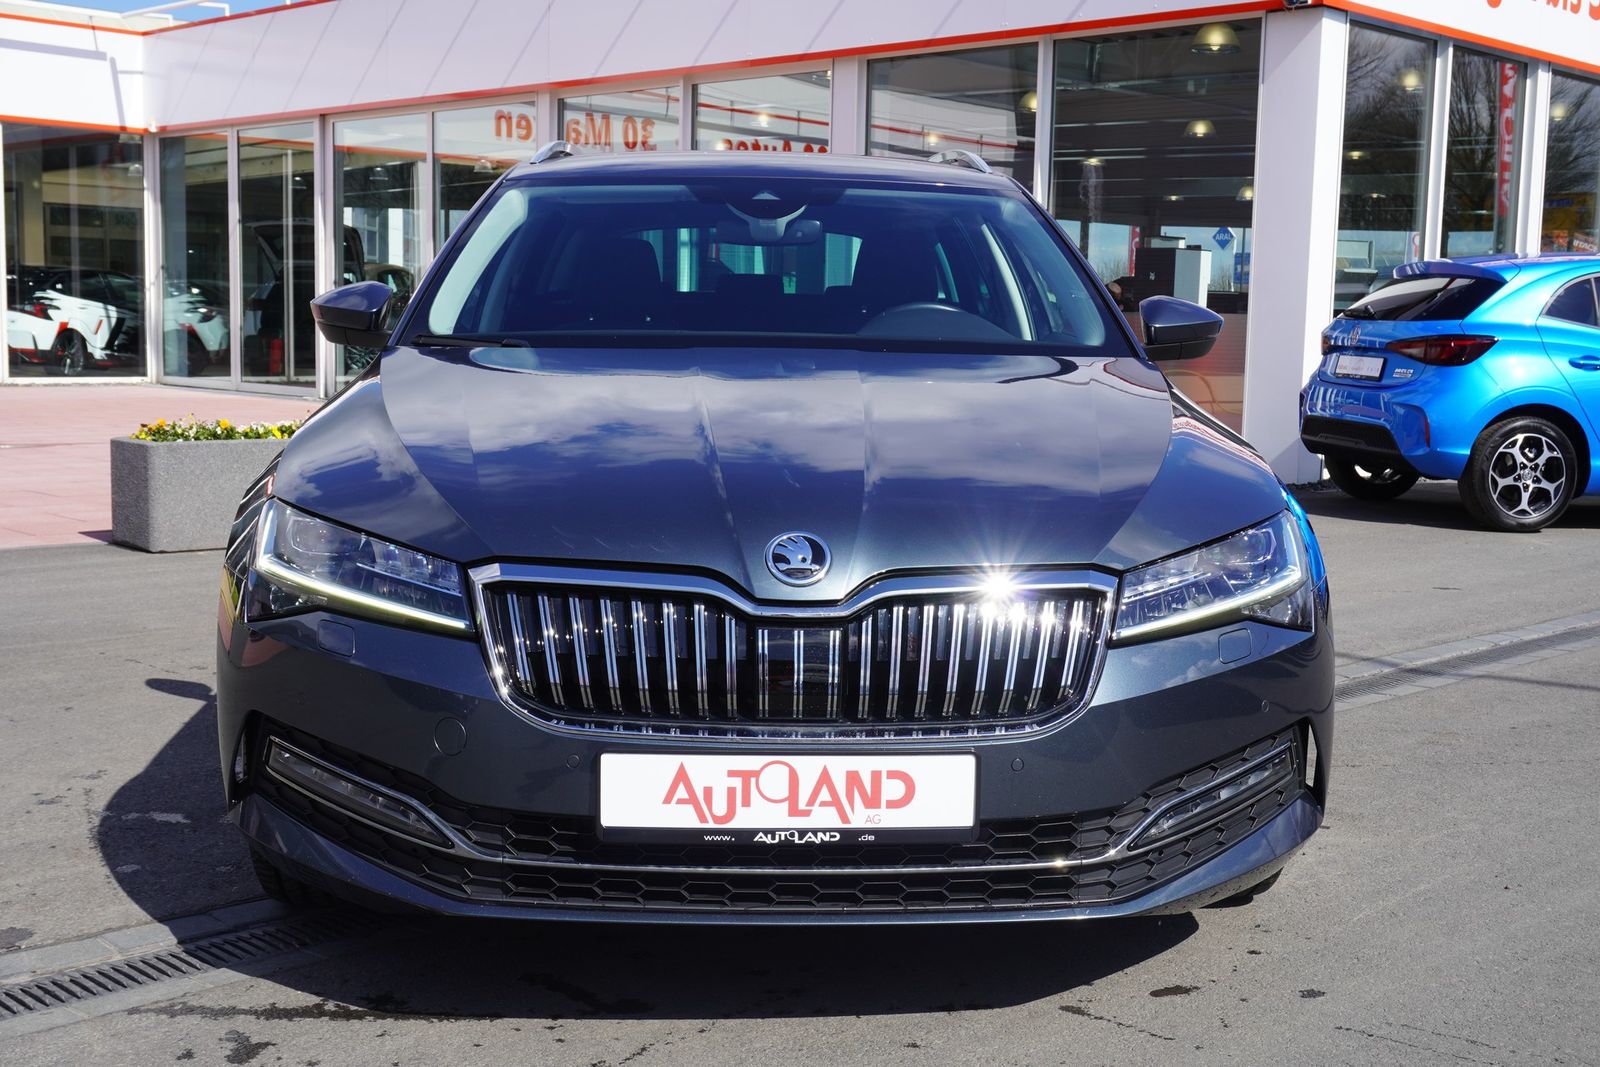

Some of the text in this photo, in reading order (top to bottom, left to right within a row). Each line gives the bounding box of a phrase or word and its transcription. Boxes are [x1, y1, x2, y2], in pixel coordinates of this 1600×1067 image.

[1215, 232, 1232, 241] ARAL
[662, 761, 916, 824] AUTOLAND
[864, 814, 882, 825] AG
[858, 833, 875, 841] .de
